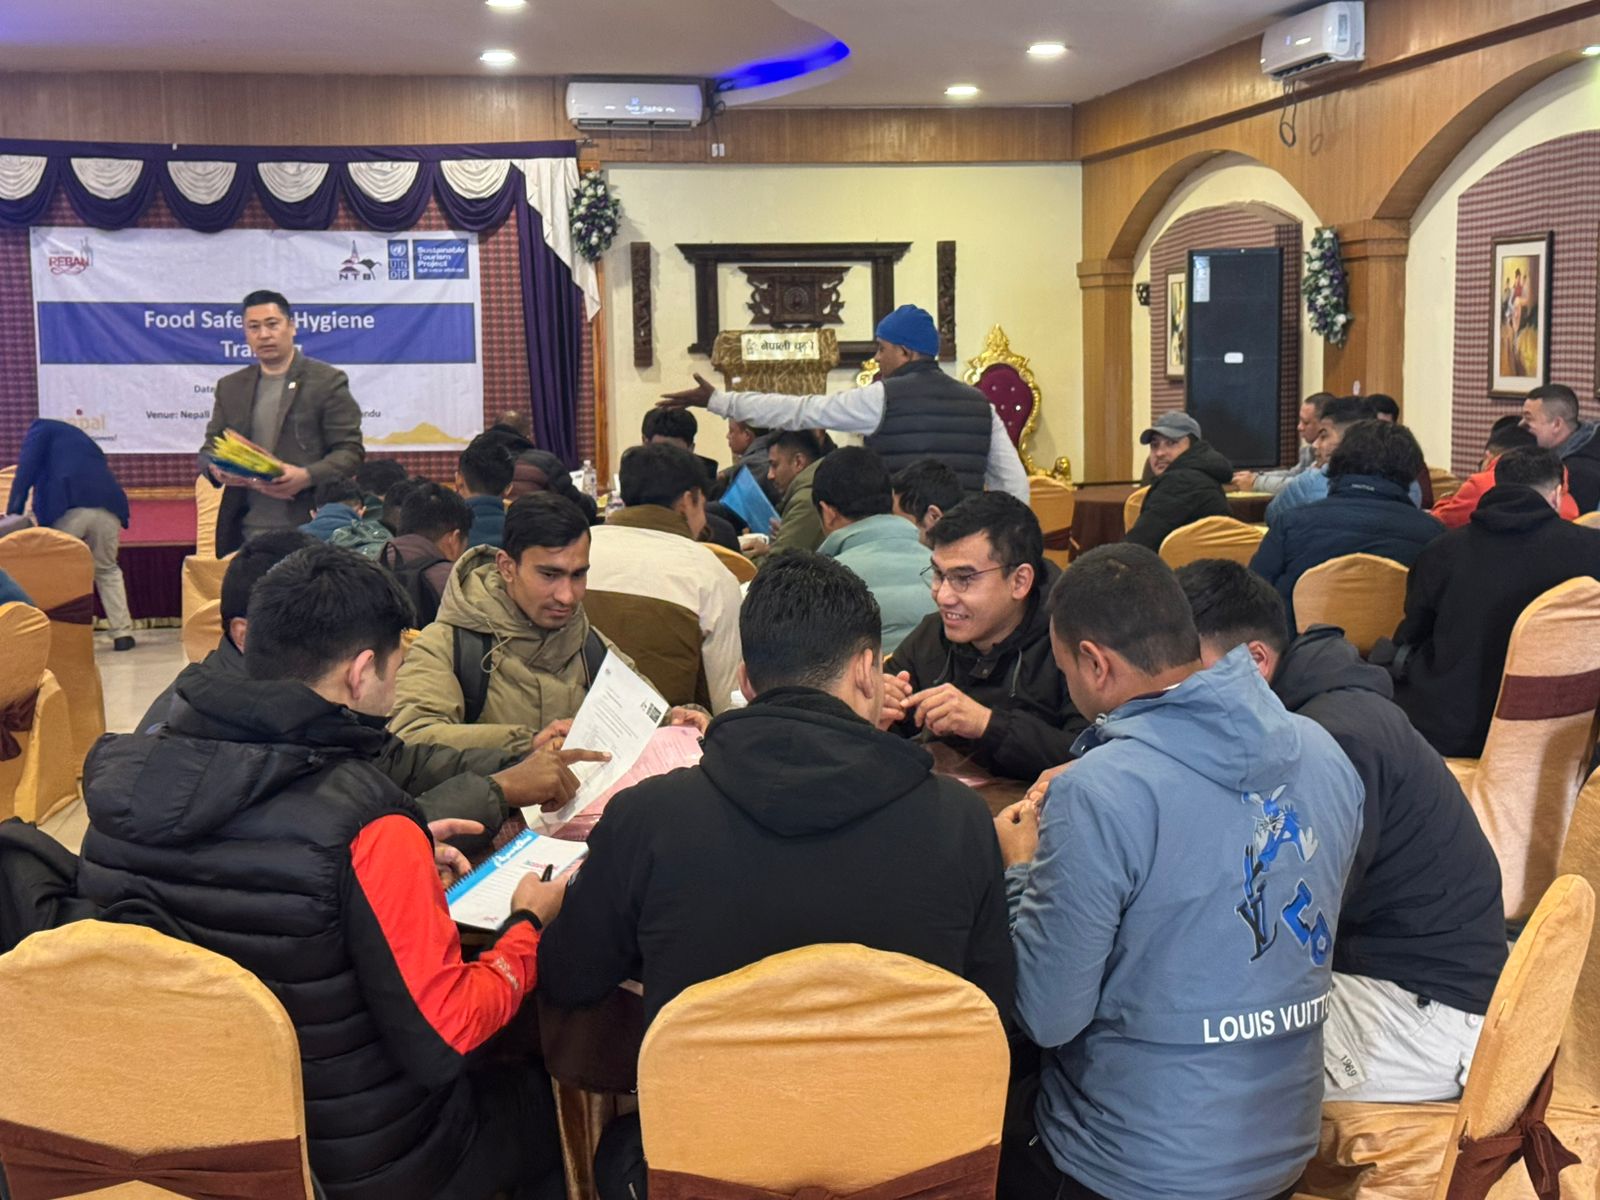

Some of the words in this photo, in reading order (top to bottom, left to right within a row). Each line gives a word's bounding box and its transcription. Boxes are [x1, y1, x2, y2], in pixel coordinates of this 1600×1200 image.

[417, 260, 448, 268] Project
[144, 311, 195, 329] Food
[201, 310, 243, 329] Safe
[293, 311, 375, 333] Hygiene
[1203, 1010, 1276, 1044] LOUIS
[1340, 1054, 1358, 1078] 1969
